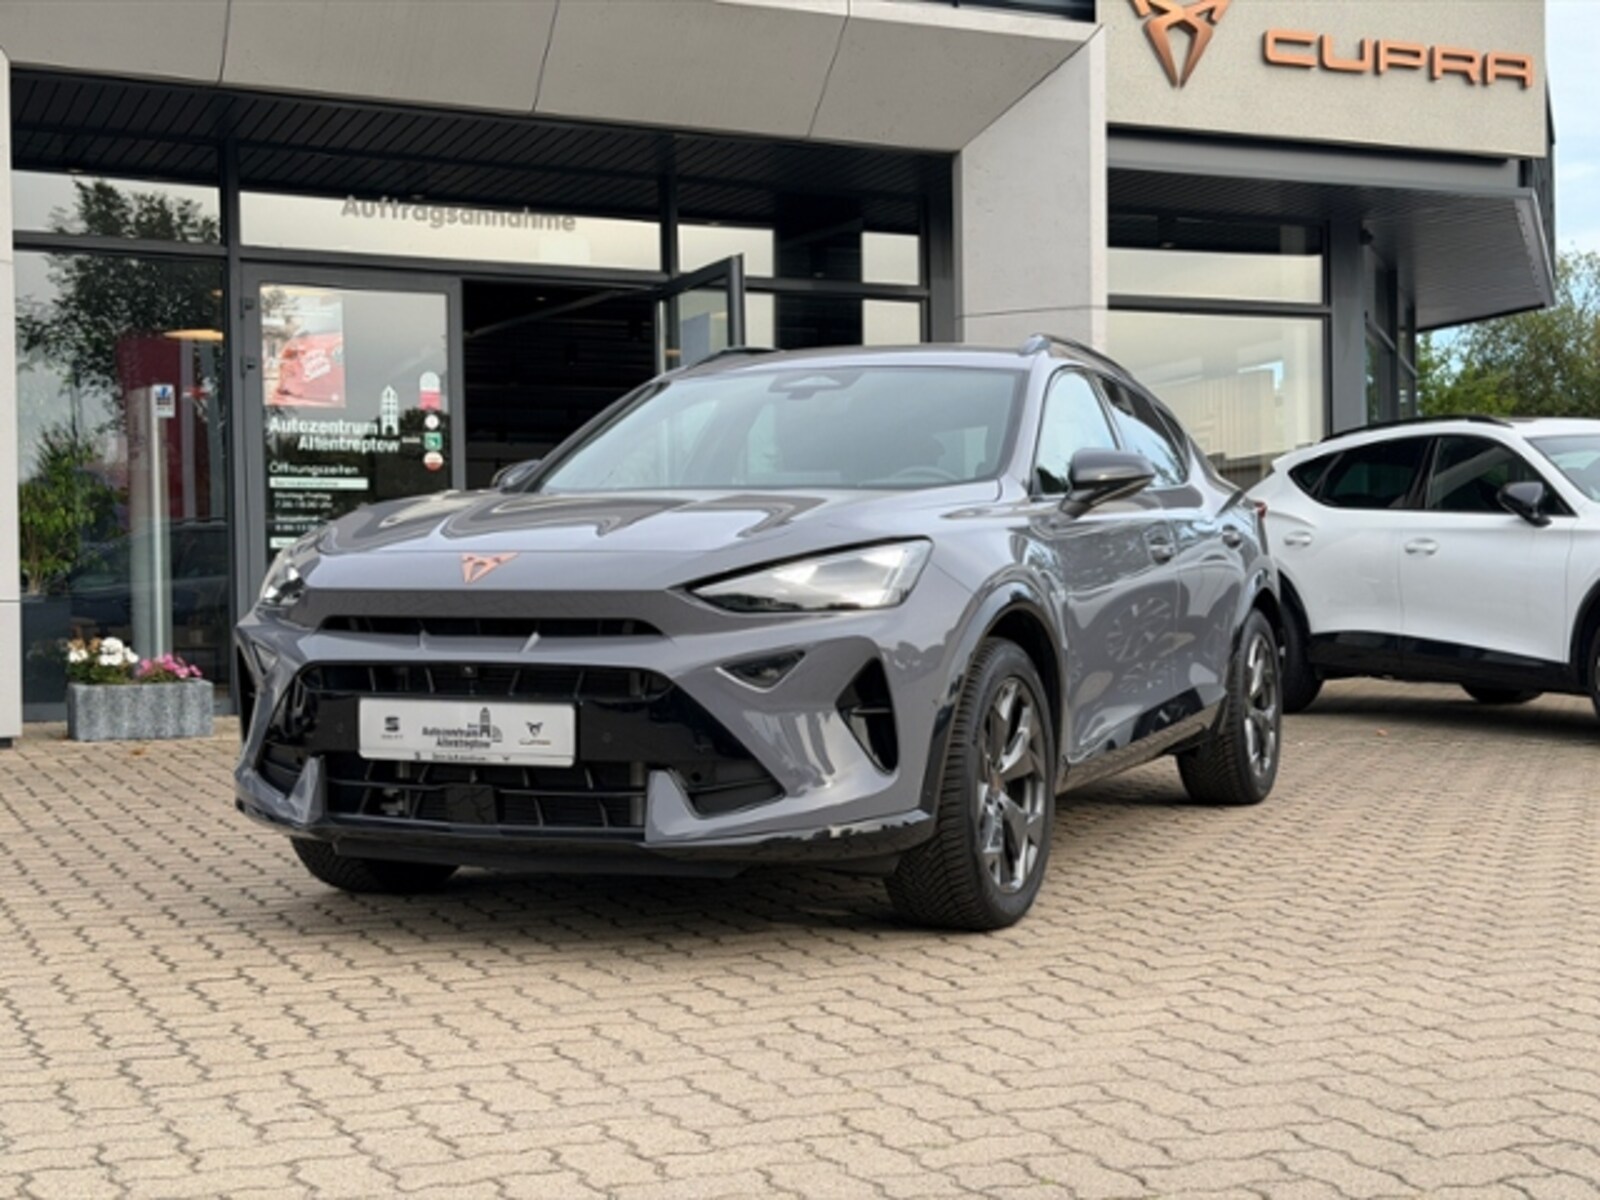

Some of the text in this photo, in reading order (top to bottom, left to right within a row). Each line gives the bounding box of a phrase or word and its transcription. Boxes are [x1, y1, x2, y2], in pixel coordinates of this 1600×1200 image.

[1263, 28, 1533, 90] CUPRA
[341, 194, 576, 232] Auftragsannahme
[269, 416, 378, 436] Autozentrum
[298, 435, 399, 454] Altentreptow
